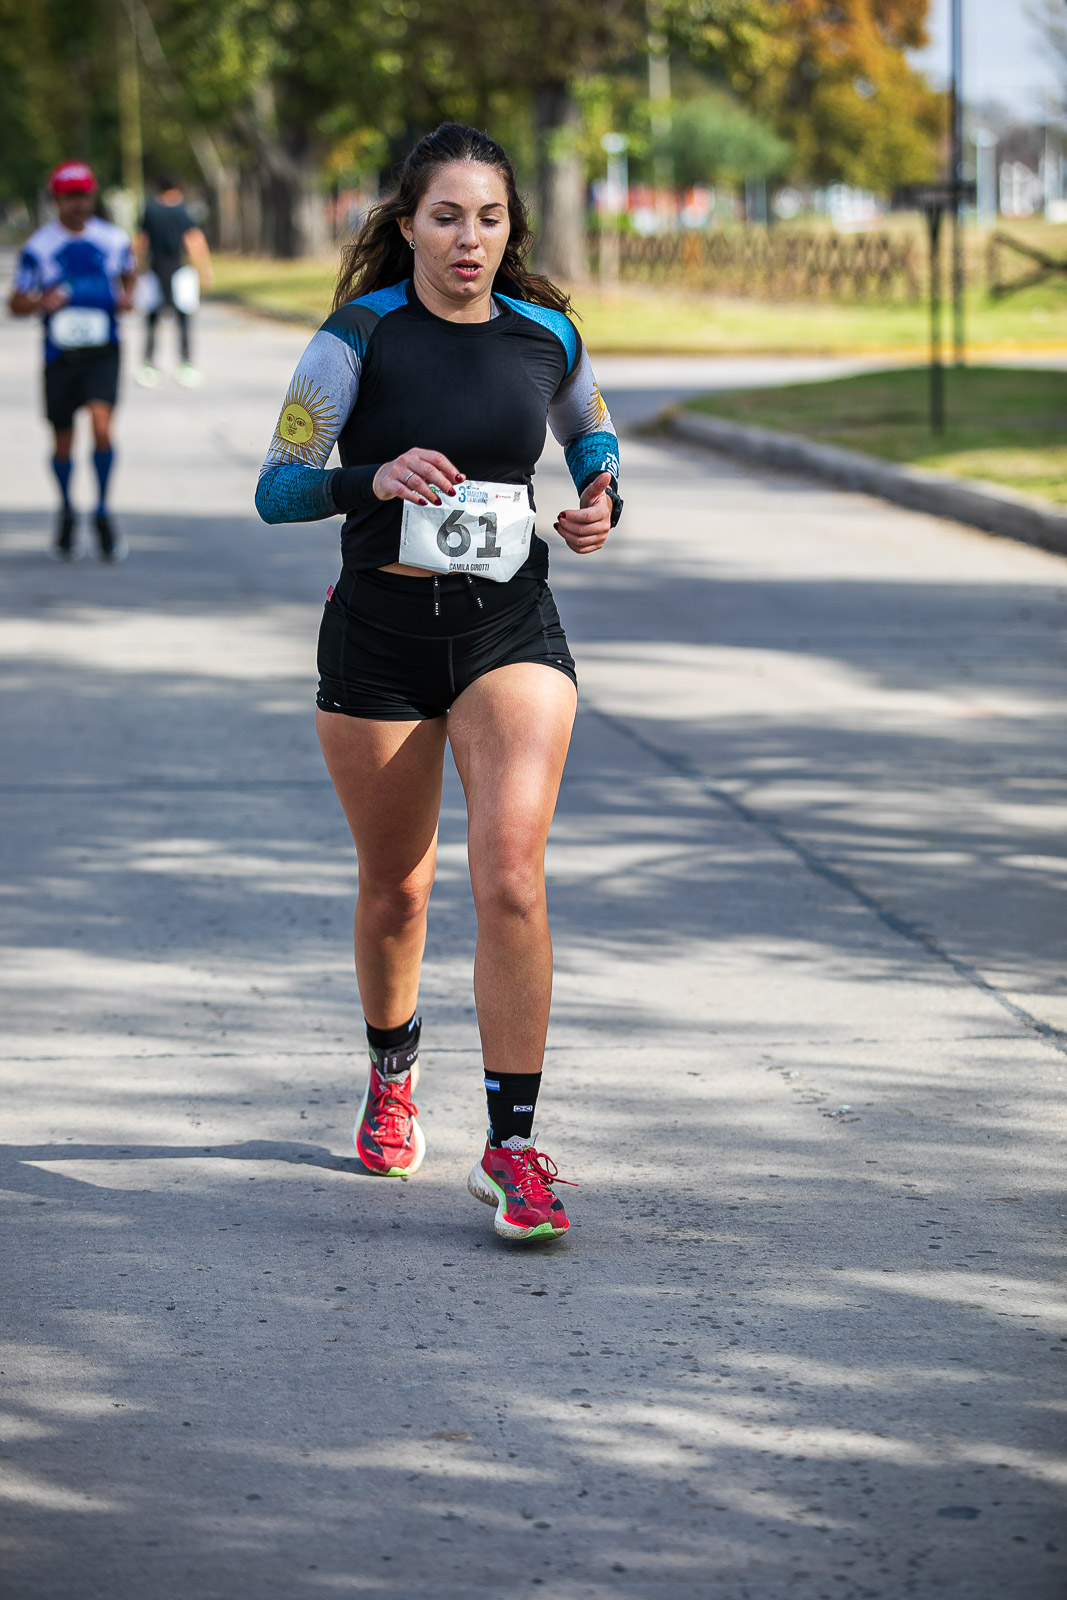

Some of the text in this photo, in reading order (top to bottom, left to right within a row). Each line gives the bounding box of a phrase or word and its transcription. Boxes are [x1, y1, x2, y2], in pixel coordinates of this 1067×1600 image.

[458, 485, 466, 503] 3
[436, 509, 502, 558] 61
[449, 562, 490, 572] CAMILA GIROTTI
